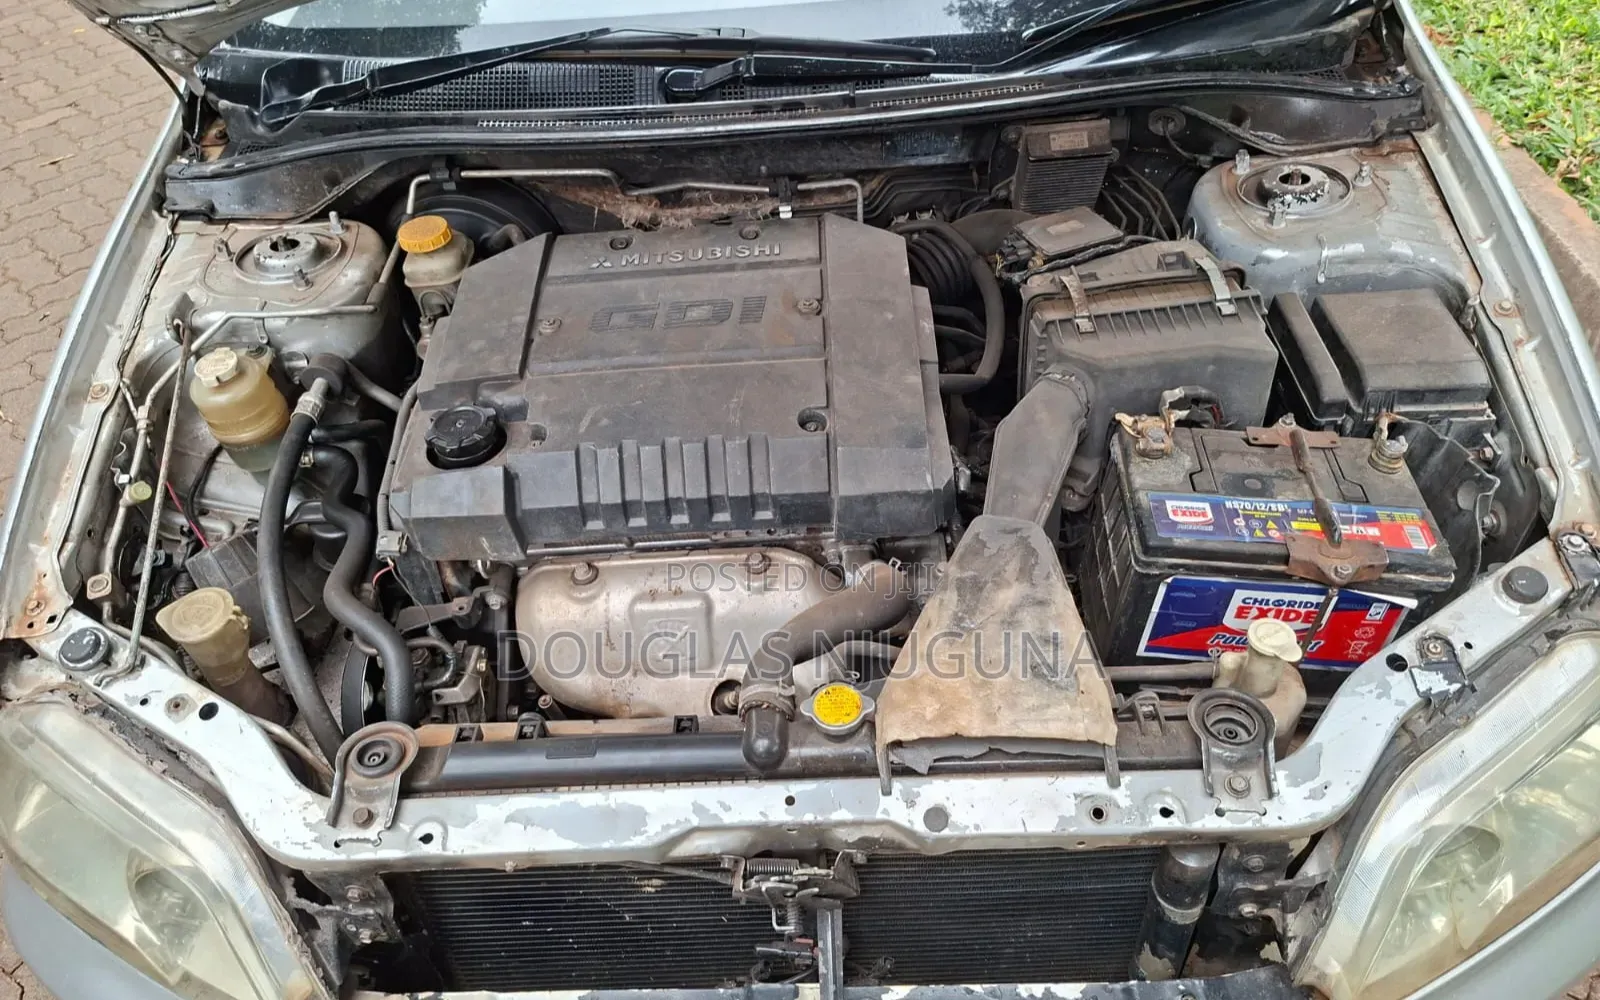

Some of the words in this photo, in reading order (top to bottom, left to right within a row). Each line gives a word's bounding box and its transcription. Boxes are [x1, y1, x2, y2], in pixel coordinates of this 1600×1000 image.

[620, 243, 781, 267] MITSUBISHI
[588, 296, 767, 333] GDI
[1172, 509, 1208, 519] EXIDE
[1234, 604, 1321, 624] EXIDE
